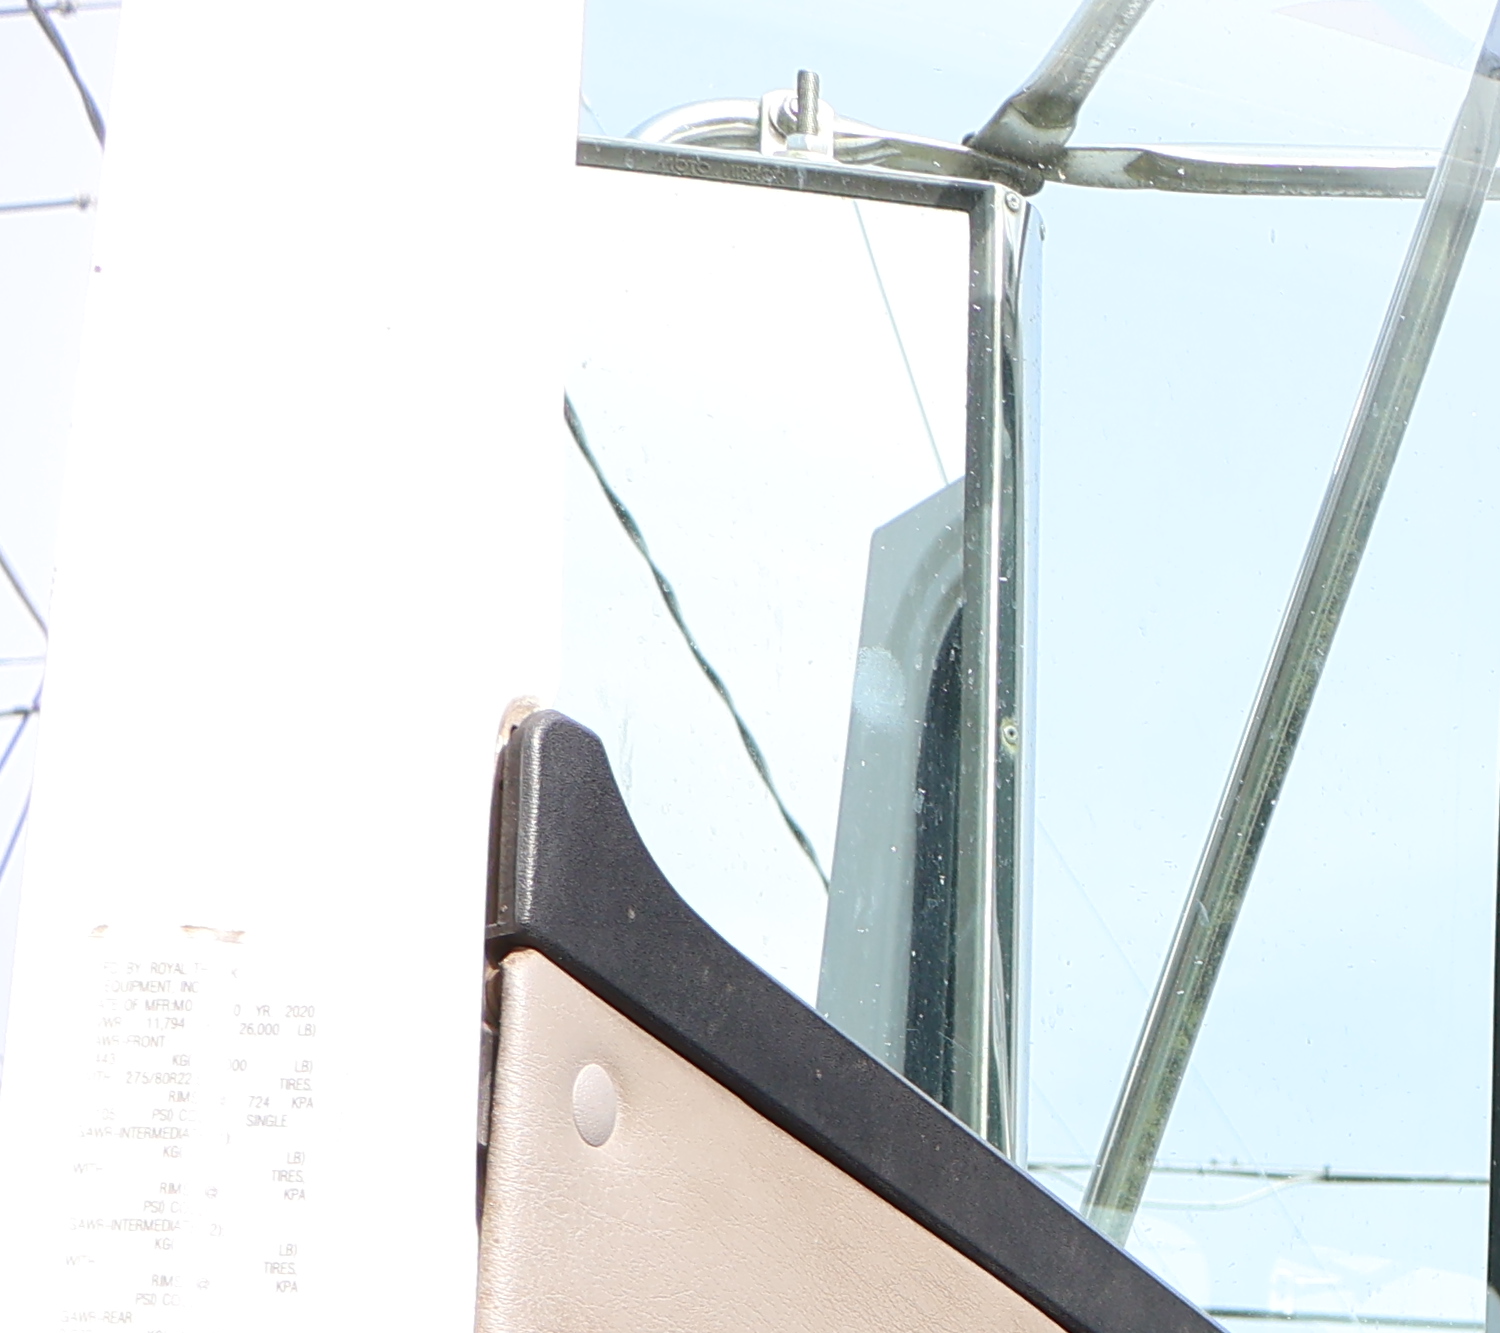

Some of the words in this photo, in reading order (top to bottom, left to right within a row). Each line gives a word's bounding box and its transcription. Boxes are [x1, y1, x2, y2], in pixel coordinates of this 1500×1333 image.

[150, 962, 187, 975] ROYAL
[124, 998, 138, 1011] OF
[285, 1005, 315, 1018] 2020
[147, 1016, 185, 1031] 11,794
[239, 1023, 280, 1037] 26,000
[297, 1023, 316, 1037] LB)
[294, 1059, 313, 1074] LB)
[248, 1096, 270, 1108] 724
[291, 1096, 313, 1109] KPA
[246, 1114, 288, 1127] SINGLE
[287, 1152, 305, 1166] LB)
[284, 1188, 306, 1201] KPA
[279, 1244, 297, 1258] LB)
[276, 1280, 298, 1293] KPA
